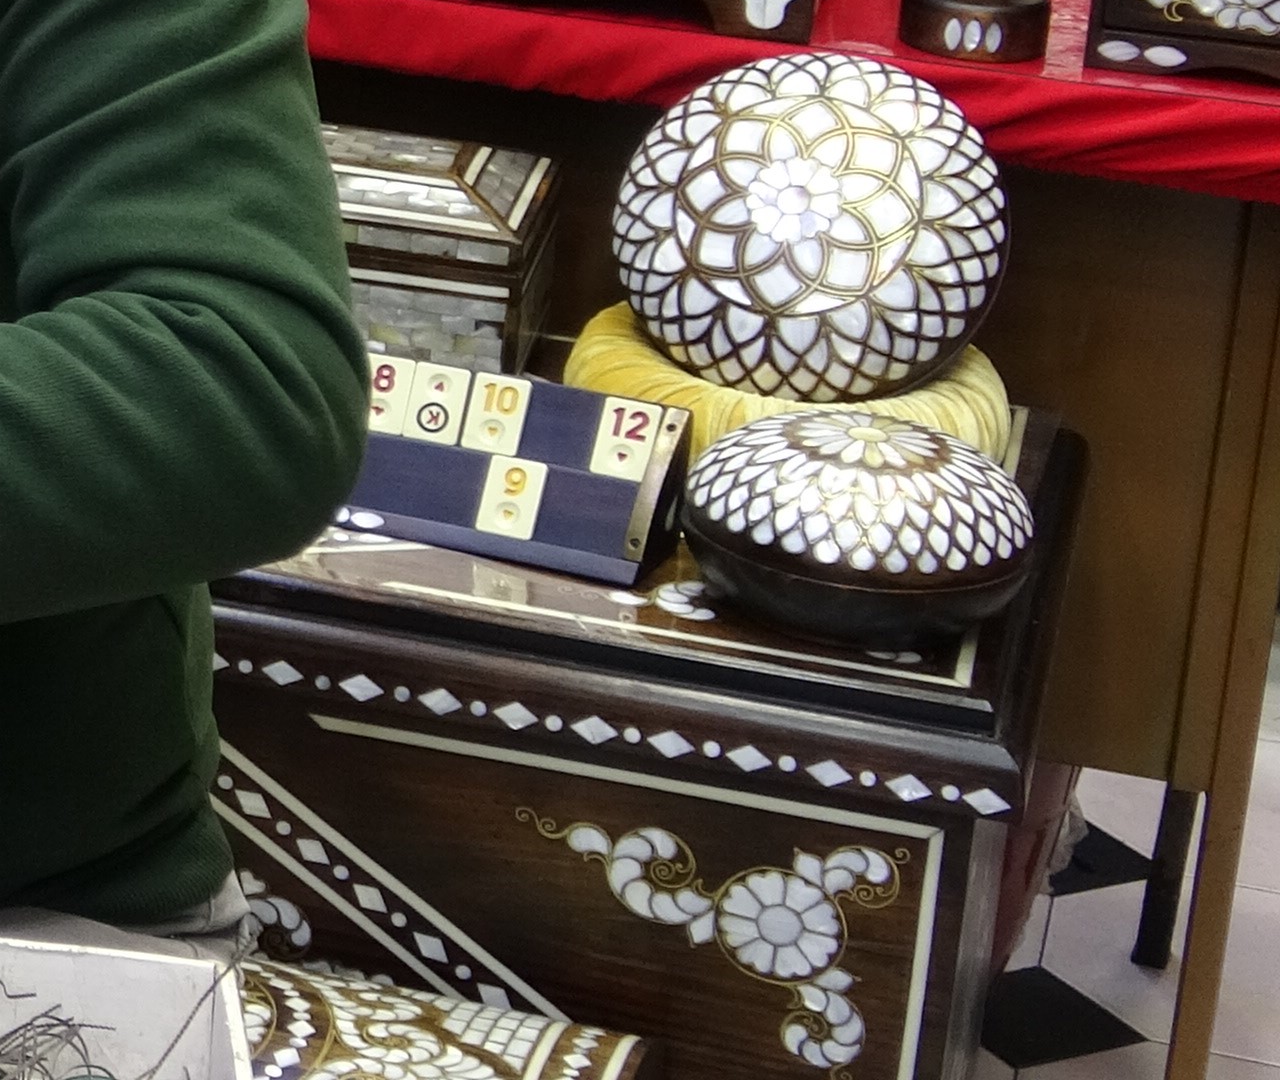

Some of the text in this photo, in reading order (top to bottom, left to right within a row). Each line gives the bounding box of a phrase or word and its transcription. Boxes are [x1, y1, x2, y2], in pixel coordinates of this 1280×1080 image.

[373, 364, 397, 393] 8
[483, 381, 521, 416] 10
[611, 406, 650, 443] 12
[503, 466, 529, 497] 9
